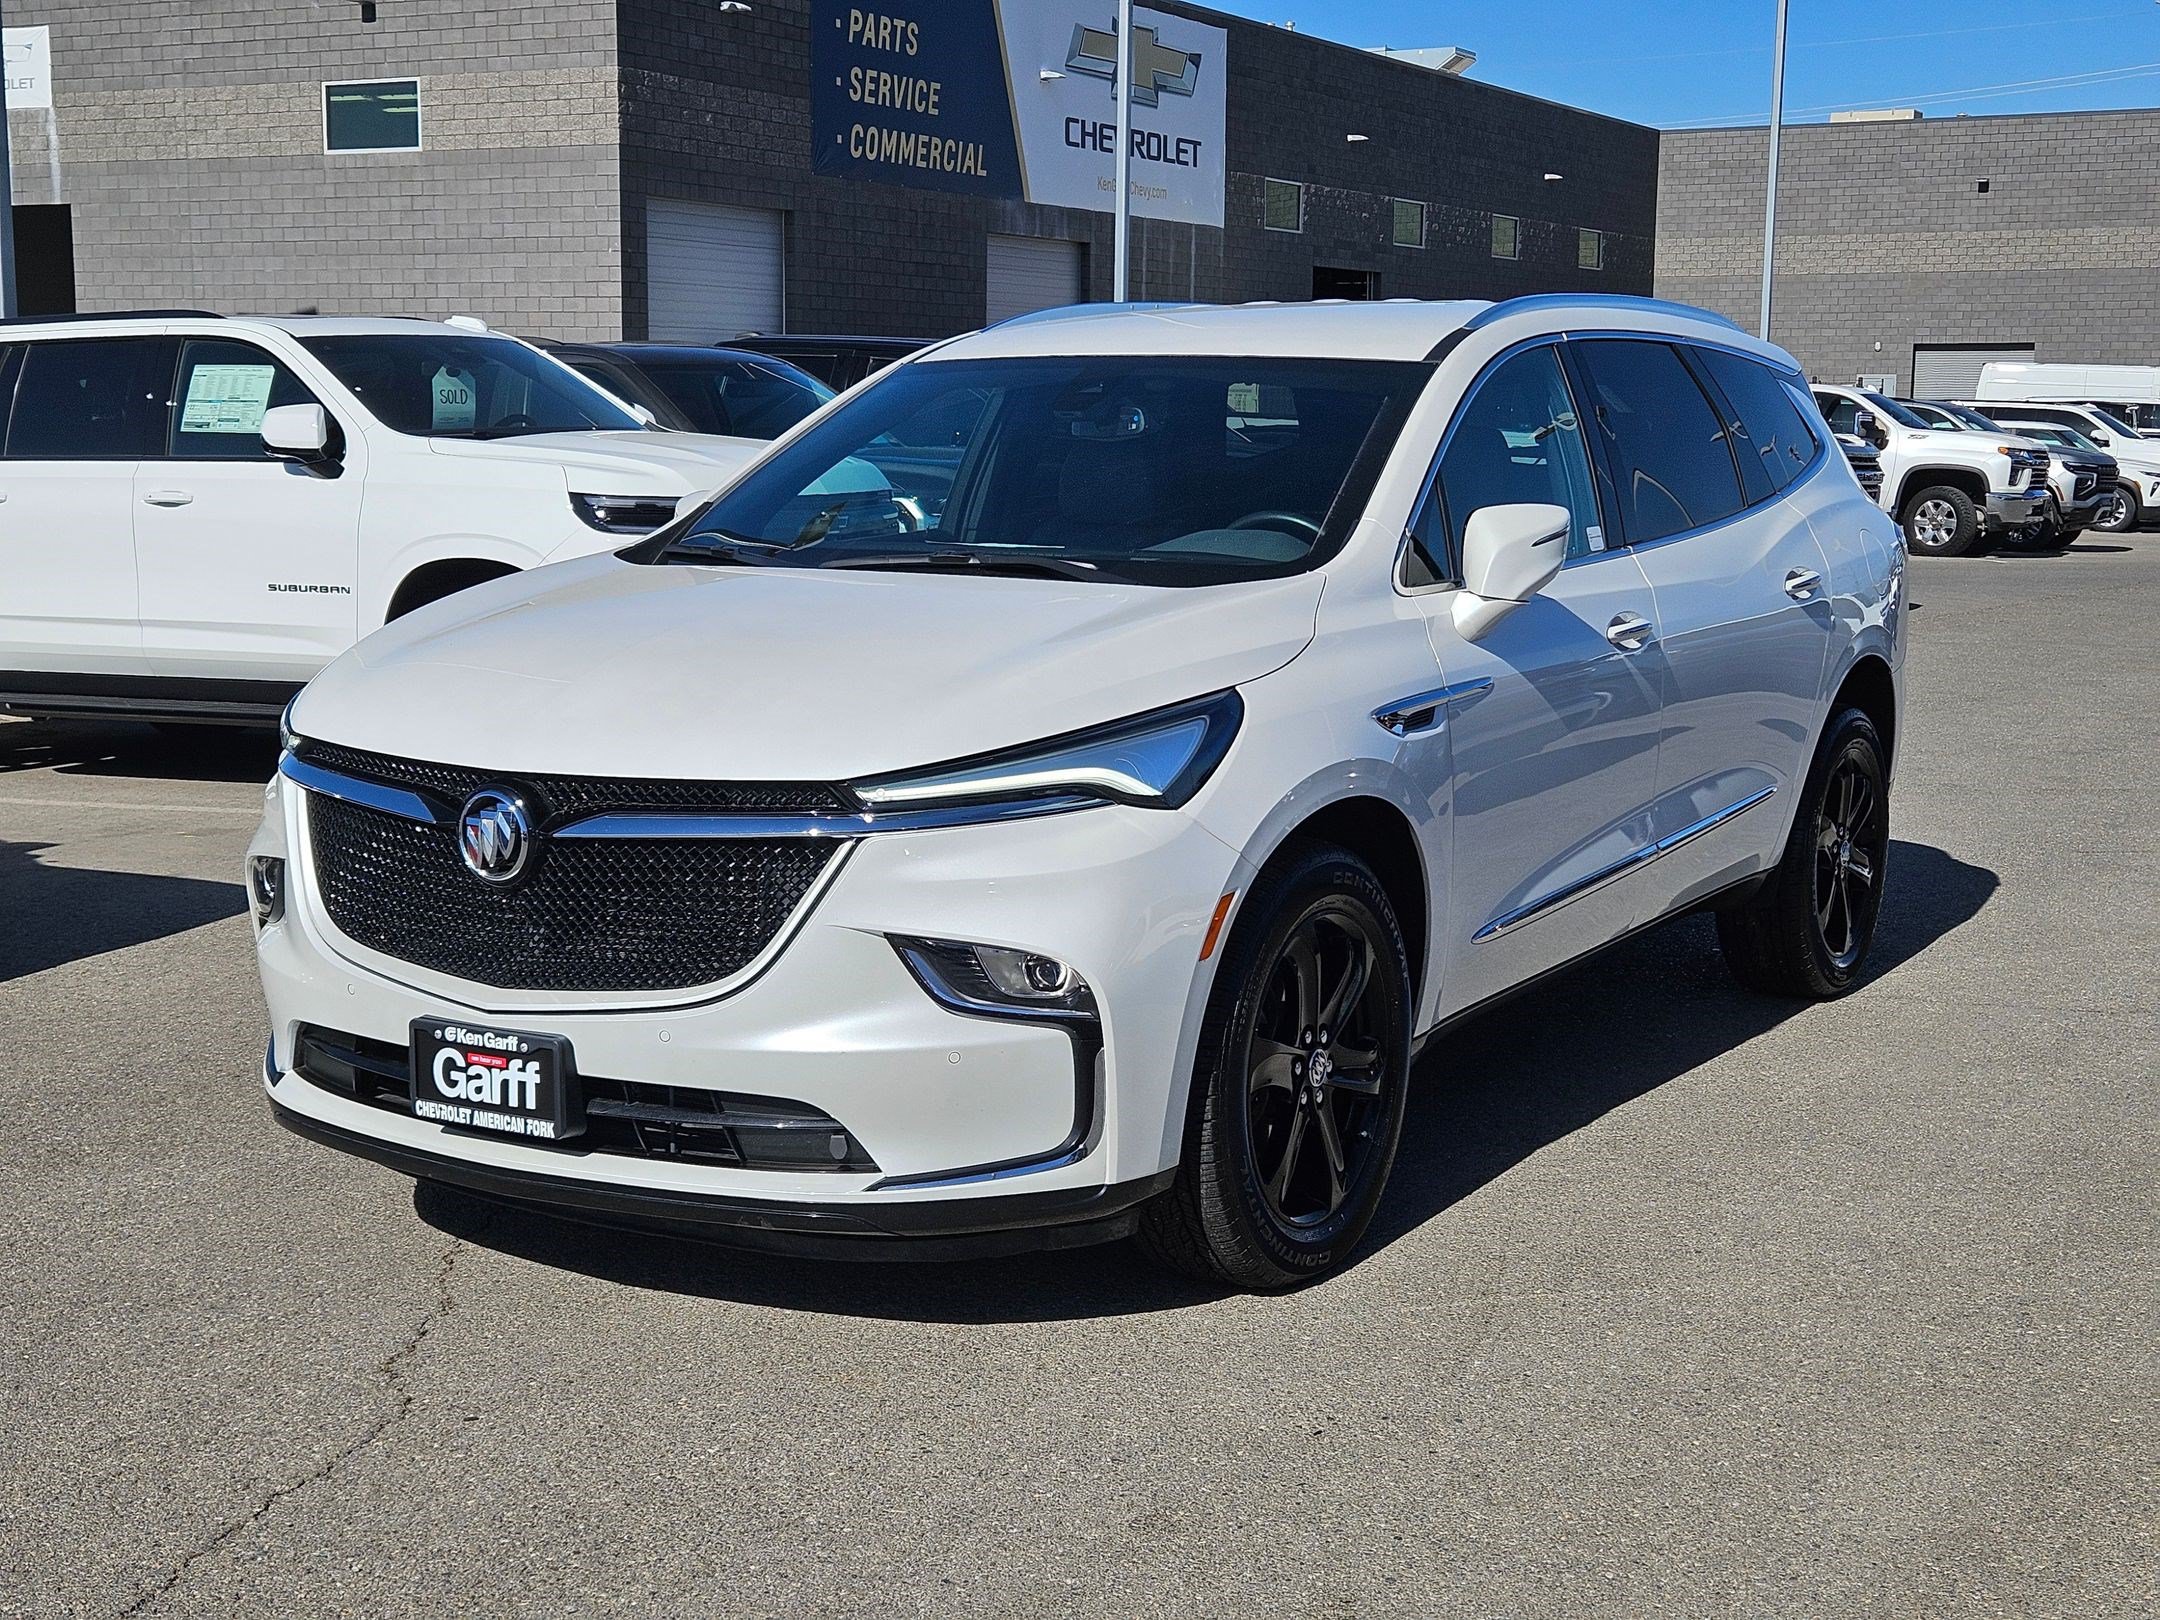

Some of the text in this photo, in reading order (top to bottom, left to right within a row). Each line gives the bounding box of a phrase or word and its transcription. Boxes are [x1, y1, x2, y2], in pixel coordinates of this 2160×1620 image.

[849, 9, 919, 56] PARTS
[849, 66, 941, 116] SERVICE
[850, 124, 987, 177] COMMERCIAL
[1065, 116, 1202, 168] CHEROLET
[440, 389, 468, 405] SOLD
[268, 584, 351, 595] SUBURBAN
[433, 1047, 541, 1110] Garff
[415, 1100, 555, 1139] CHEVROLET AMERICAN FORK
